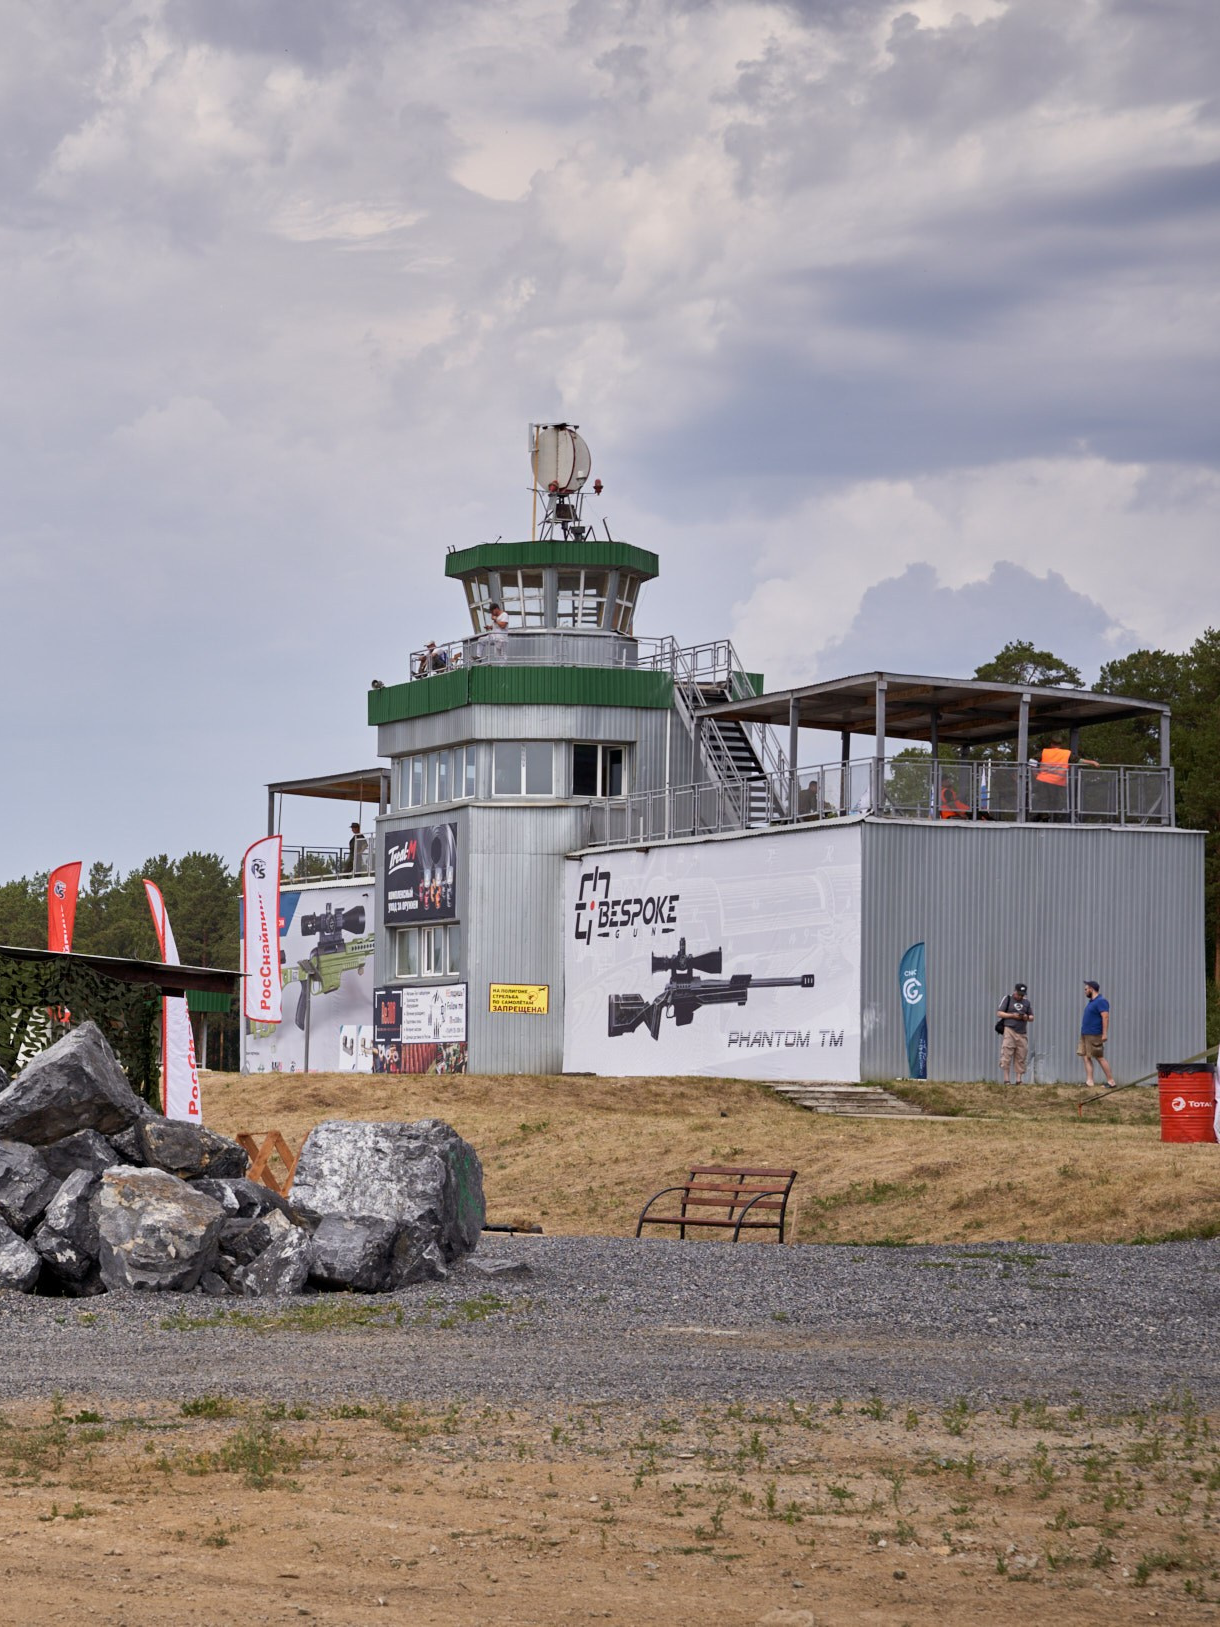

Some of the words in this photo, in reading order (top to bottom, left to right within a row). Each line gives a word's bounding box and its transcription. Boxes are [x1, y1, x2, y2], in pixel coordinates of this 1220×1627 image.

[598, 895, 680, 928] BESPOKE
[615, 928, 657, 939] GUN
[492, 1005, 545, 1013] ЗАПРЕЩЕНА!
[727, 1030, 811, 1048] PHANTOM
[819, 1029, 845, 1048] TM
